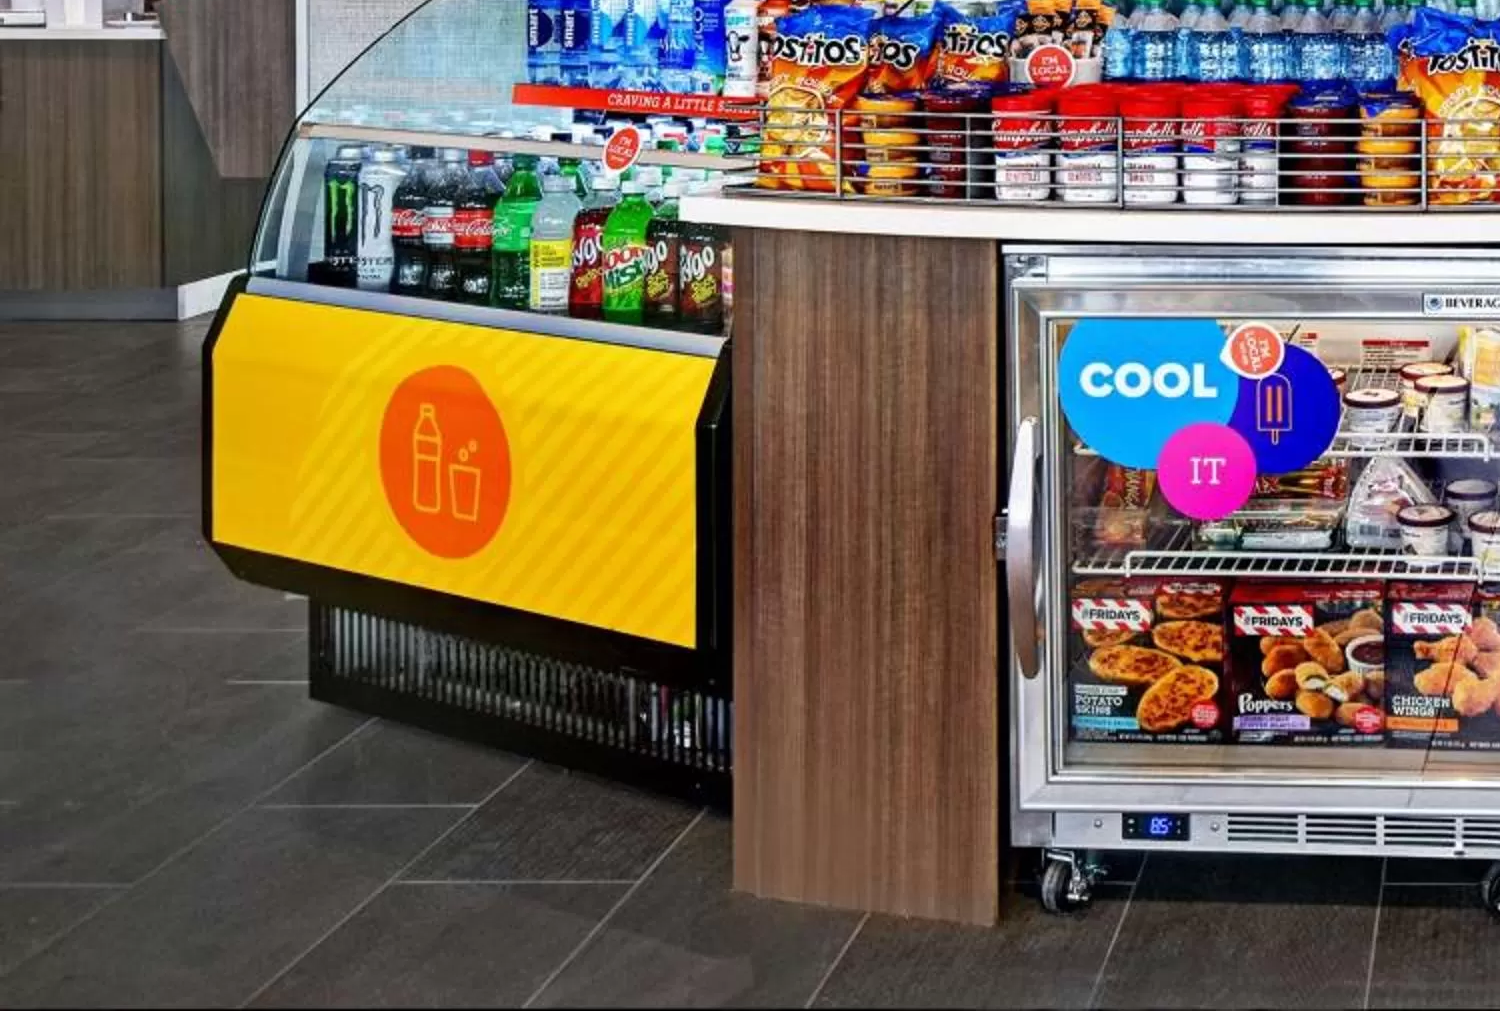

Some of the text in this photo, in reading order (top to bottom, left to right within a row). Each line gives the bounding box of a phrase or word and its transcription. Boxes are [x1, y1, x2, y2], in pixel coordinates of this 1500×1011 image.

[529, 8, 539, 47] smart
[564, 10, 575, 48] smart
[1031, 65, 1070, 77] LOCAL
[607, 92, 660, 108] CRAVING
[662, 96, 672, 108] A
[673, 98, 714, 112] LITTLE
[1080, 362, 1218, 399] COOL
[1189, 457, 1226, 486] IT
[1089, 608, 1141, 621] FRIDAYS
[1409, 612, 1463, 625] FRIDAYS
[1251, 616, 1304, 627] FRIDAYS
[1075, 694, 1123, 707] POTATO
[1237, 692, 1294, 714] Poppers
[1392, 696, 1450, 709] CHICKEN
[1393, 706, 1435, 717] WINGS
